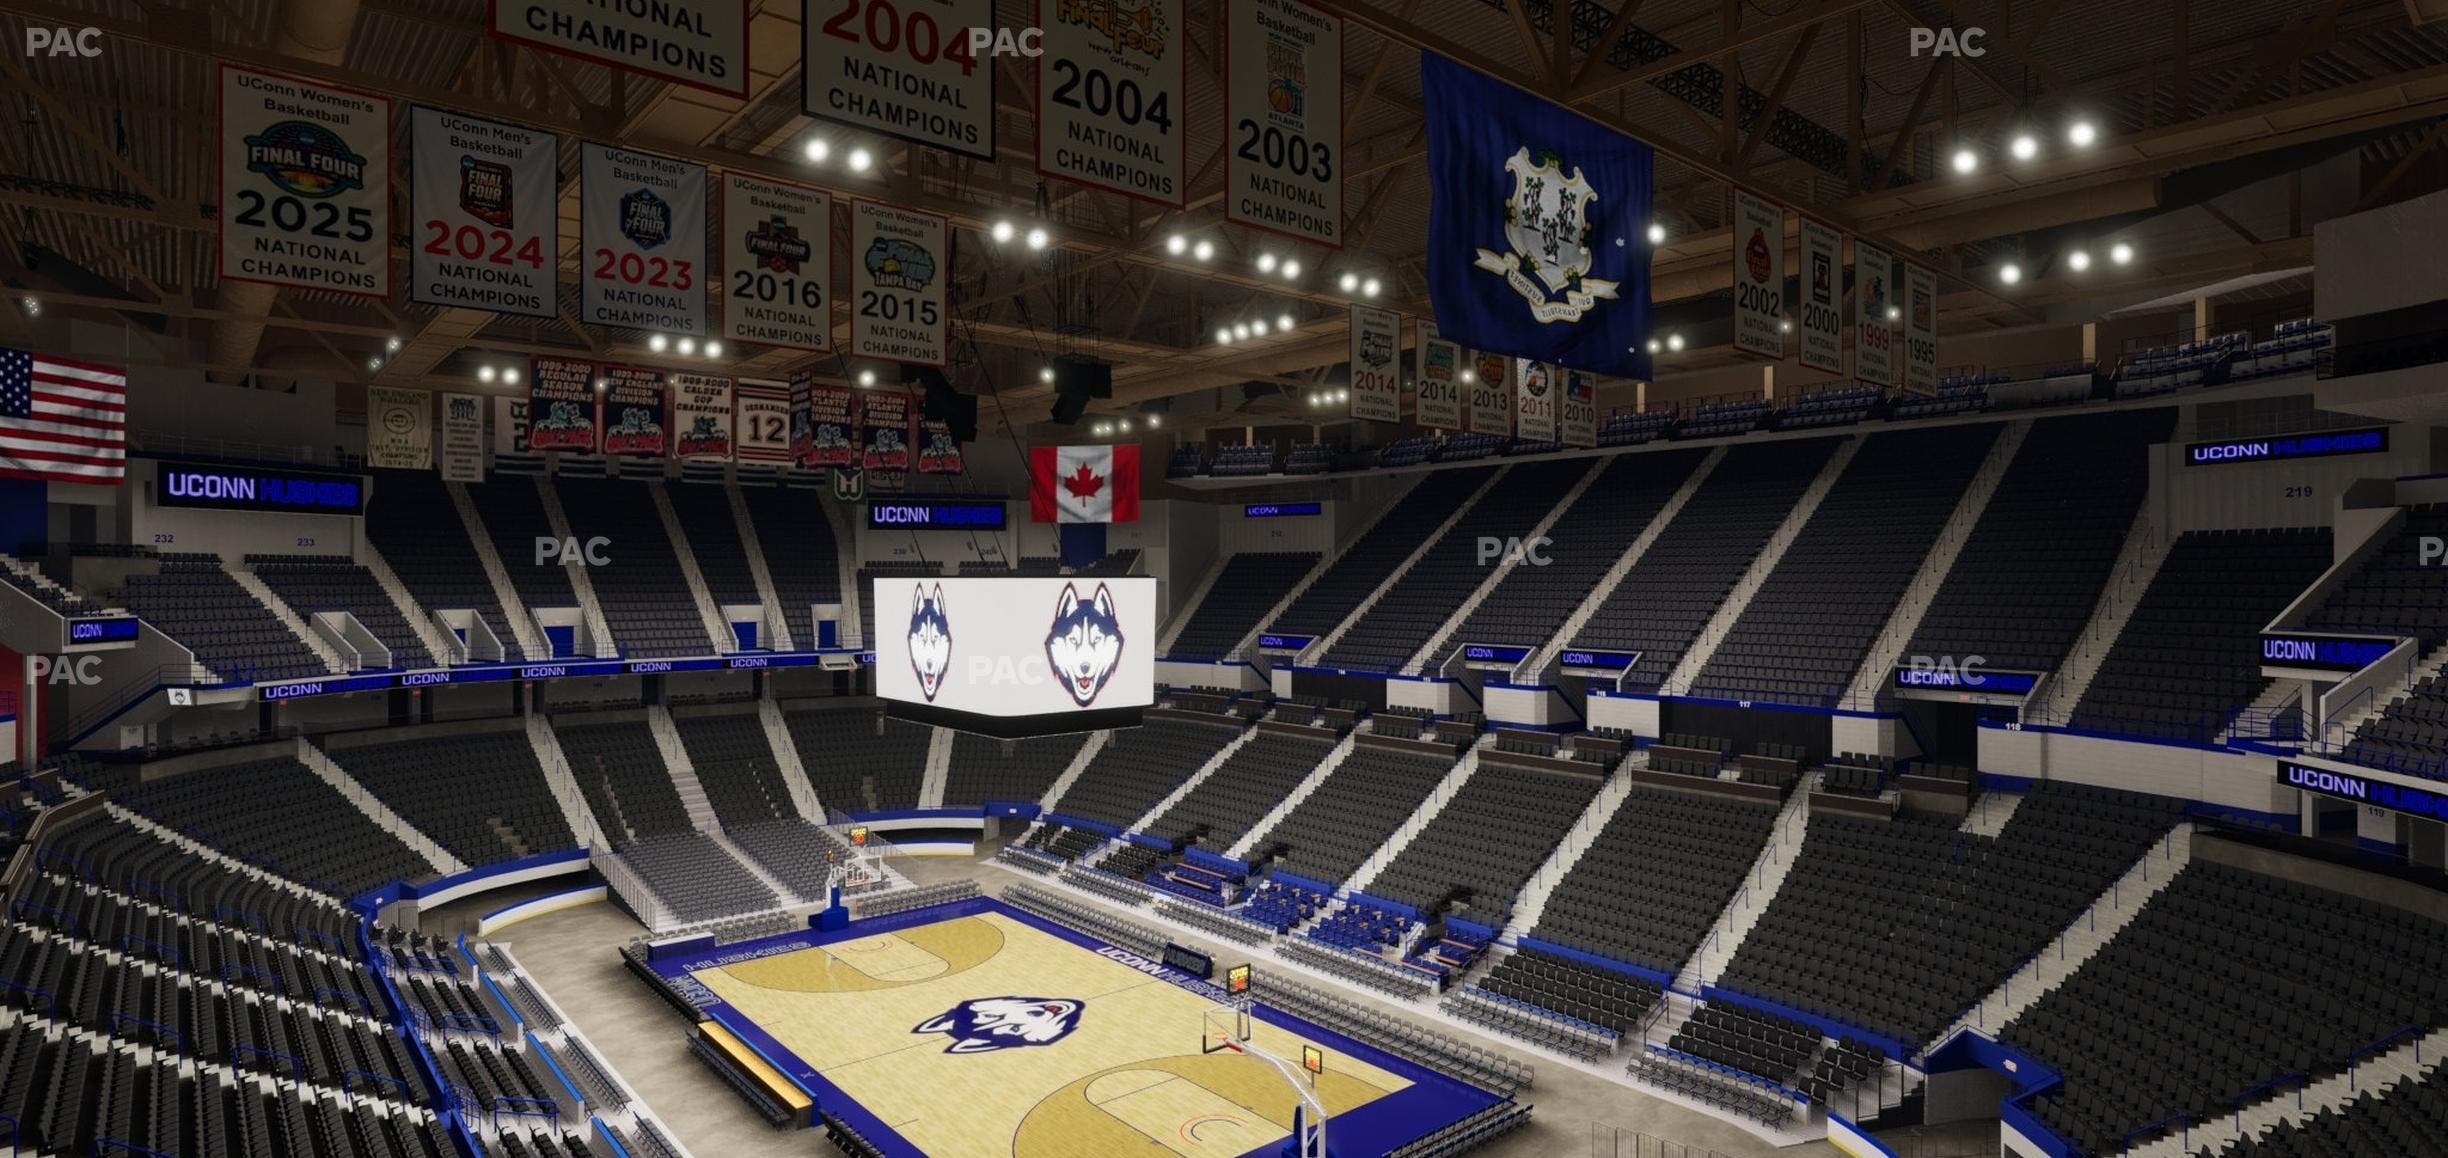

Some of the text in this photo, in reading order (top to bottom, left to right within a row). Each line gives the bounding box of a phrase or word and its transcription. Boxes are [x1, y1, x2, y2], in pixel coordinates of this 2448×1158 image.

[1257, 10, 1315, 45] Basketball
[1282, 1, 1332, 32] Women's
[526, 6, 725, 77] CHAMPIONS
[823, 0, 977, 77] 2004
[238, 75, 374, 112] UConn Women's
[844, 56, 967, 109] NATIONAL
[1052, 58, 1172, 134] 2004
[264, 98, 350, 124] Basketball
[829, 88, 977, 144] CHAMPIONS
[441, 117, 531, 145] UConn Men's
[450, 136, 522, 160] Basketball
[1069, 121, 1164, 164] NATIONAL
[1238, 118, 1332, 182] 2003
[251, 145, 360, 180] FINAL FOUR
[605, 150, 686, 176] UConn Men's
[1057, 149, 1172, 194] CHAMPIONS
[469, 168, 502, 186] FINAL
[613, 166, 678, 190] Basketball
[468, 183, 502, 202] FOUR
[734, 178, 822, 204] UConn Women's
[1250, 174, 1326, 209] NATIONAL
[236, 190, 372, 242] 2025
[750, 196, 806, 215] Basketball
[861, 204, 893, 220] UConn
[1242, 198, 1333, 236] CHAMPIONS
[256, 237, 366, 265] NATIONAL
[424, 220, 544, 269] 2024
[242, 259, 375, 288] CHAMPIONS
[440, 263, 533, 288] NATIONAL
[594, 248, 692, 292] 2023
[431, 283, 540, 310] CHAMPIONS
[604, 288, 687, 311] NATIONAL
[734, 270, 821, 308] 2016
[1739, 282, 1780, 318] 2002
[744, 307, 816, 328] NATIONAL
[861, 290, 938, 325] 2015
[596, 308, 694, 330] CHAMPIONS
[1744, 316, 1778, 334] NATIONAL
[1804, 302, 1839, 336] 2000
[736, 324, 822, 346] CHAMPIONS
[870, 324, 932, 344] NATIONAL
[1740, 332, 1780, 353] CHAMPIONS
[863, 340, 938, 360] CHAMPIONS
[1908, 338, 1934, 364] 1995
[539, 370, 588, 382] REGULAR
[542, 380, 585, 392] SEASON
[1354, 370, 1396, 394] 2014
[532, 388, 594, 402] CHAMPIONS
[609, 394, 658, 406] CHAMPIONS
[694, 395, 713, 404] CUP
[1360, 394, 1393, 406] NATIONAL
[1420, 380, 1458, 403] 2014
[1472, 388, 1508, 410] 2013
[676, 402, 730, 414] CHAMPIONS
[1356, 406, 1396, 419] CHAMPIONS
[1424, 403, 1454, 416] NATIONAL
[1520, 396, 1551, 417] 2011
[1564, 403, 1594, 424] 2010
[750, 414, 785, 442] 12
[1420, 414, 1456, 427] CHAMPIONS
[2194, 442, 2268, 460] UCONN
[168, 472, 255, 500] UCONN
[2286, 486, 2312, 498] 219
[874, 506, 930, 523] UCONN
[154, 533, 174, 544] 232
[73, 623, 102, 638] UCONN
[1259, 636, 1282, 646] UCONN
[1466, 646, 1494, 658] UCONN
[1562, 653, 1593, 664] UCONN
[2264, 640, 2316, 660] UCONN
[521, 666, 566, 678] UCONN
[630, 662, 672, 672] UCONN
[730, 658, 768, 668] UCONN
[402, 672, 450, 686] UCONN
[1900, 670, 1956, 685] UCONN
[266, 682, 323, 700] UCONN
[2289, 765, 2366, 798] UCONN
[1096, 946, 1169, 980] UCONN
